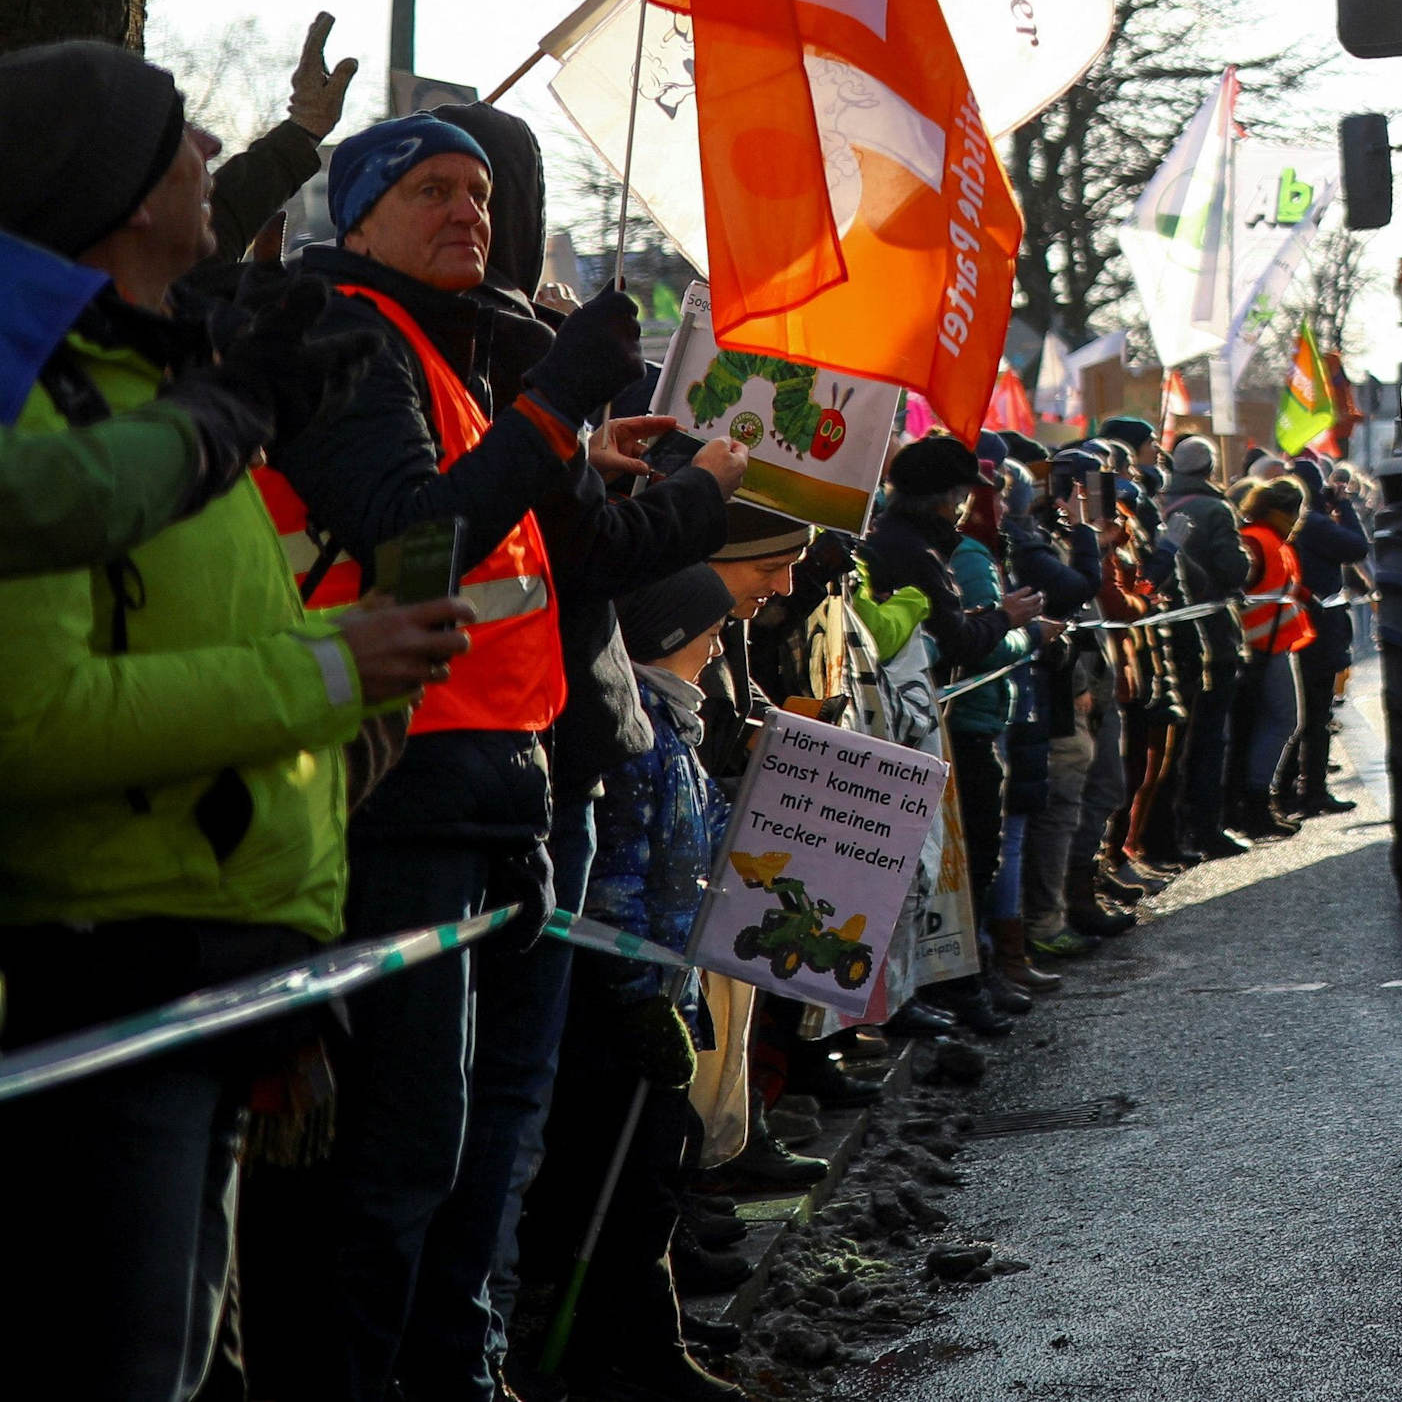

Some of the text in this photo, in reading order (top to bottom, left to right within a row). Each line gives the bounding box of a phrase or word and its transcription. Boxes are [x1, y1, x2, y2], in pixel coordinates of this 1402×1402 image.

[762, 754, 928, 818] Sonst komme ich
[782, 727, 929, 786] Hört auf mich!
[750, 810, 906, 874] Trecker wieder!
[780, 792, 892, 838] mit meinem
